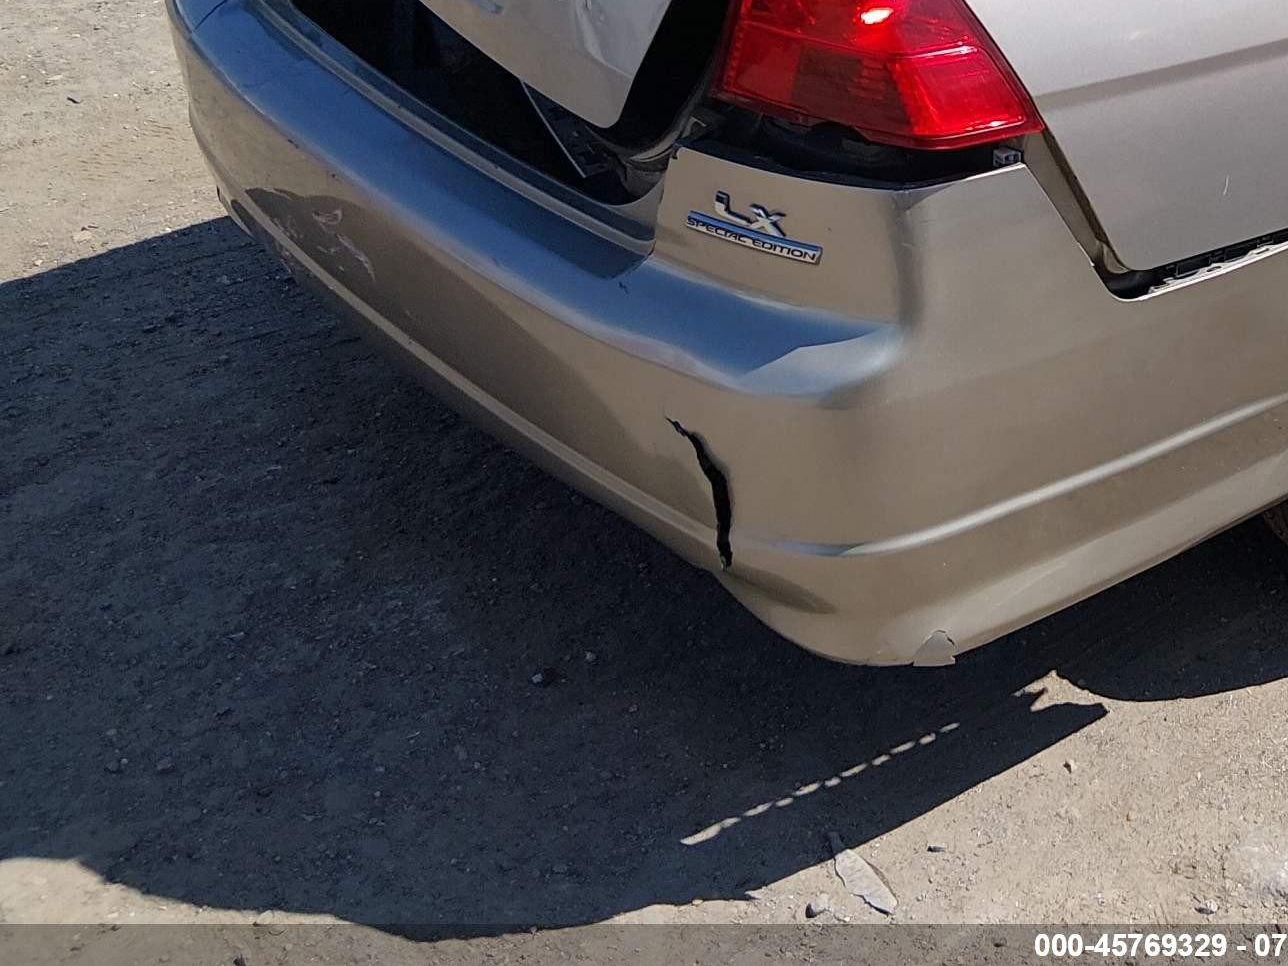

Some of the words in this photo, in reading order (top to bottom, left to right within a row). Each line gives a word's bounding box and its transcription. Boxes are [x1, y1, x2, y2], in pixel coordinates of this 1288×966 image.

[714, 190, 787, 237] LX
[687, 217, 747, 243] SPECIAL
[752, 238, 817, 262] EDITION
